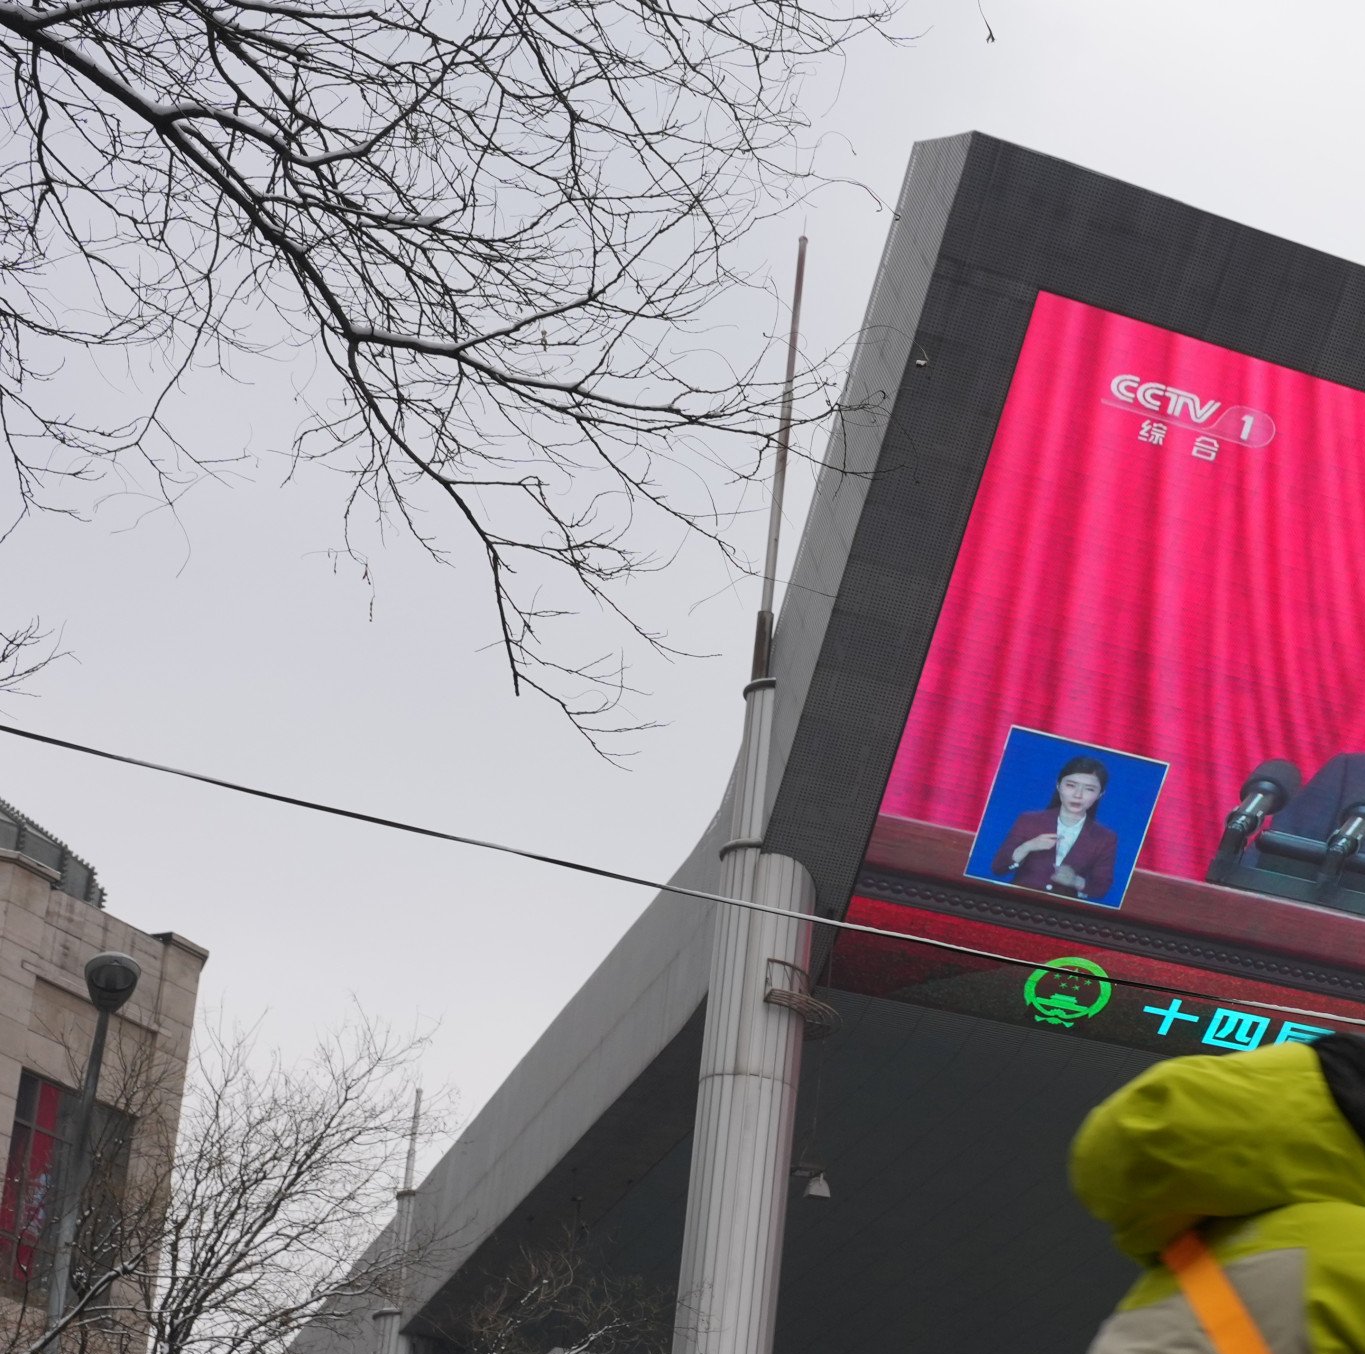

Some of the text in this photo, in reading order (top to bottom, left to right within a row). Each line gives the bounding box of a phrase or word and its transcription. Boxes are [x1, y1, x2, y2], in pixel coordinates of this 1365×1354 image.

[1110, 374, 1255, 441] CCTV 1
[1137, 419, 1220, 462] 综合
